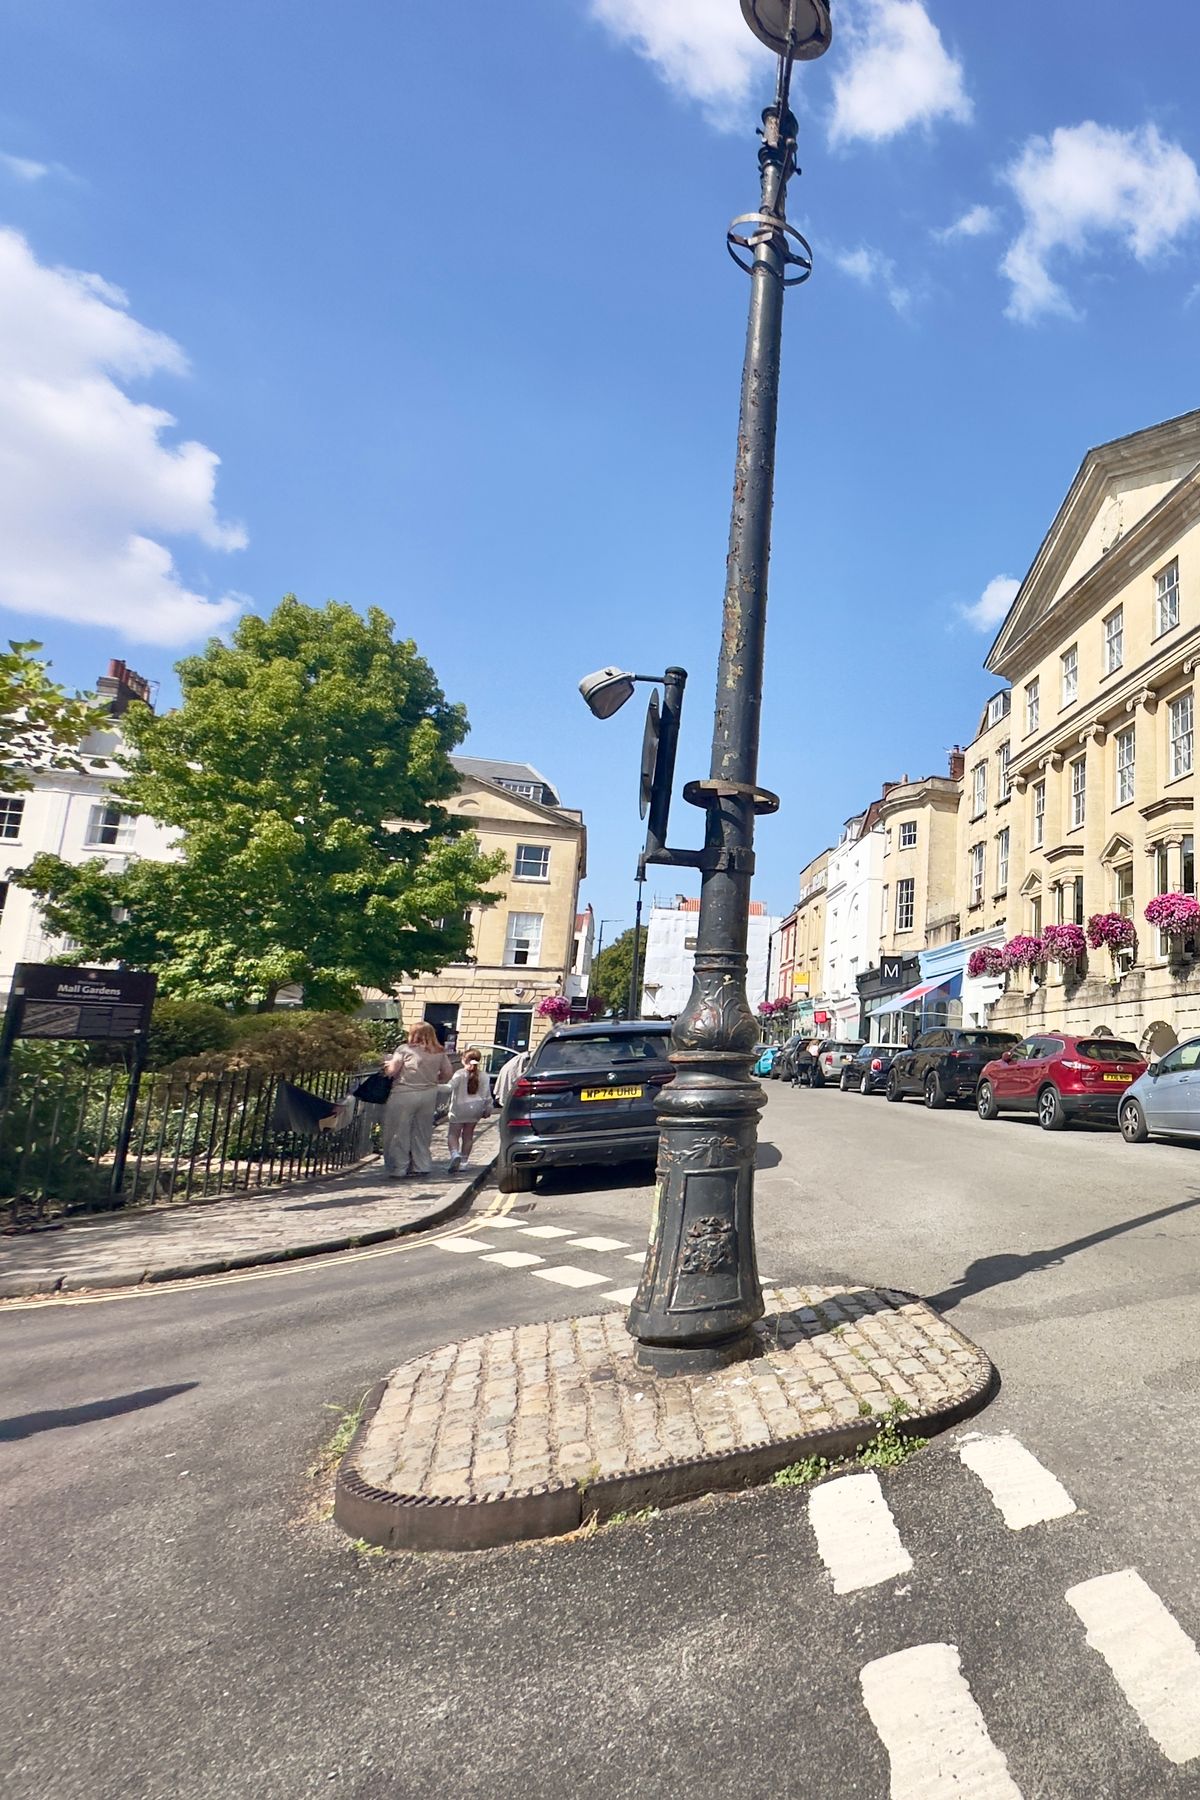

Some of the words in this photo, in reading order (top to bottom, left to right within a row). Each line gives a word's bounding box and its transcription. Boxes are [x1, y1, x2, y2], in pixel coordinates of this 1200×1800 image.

[884, 963, 899, 978] M
[57, 984, 80, 993] Mall
[82, 986, 121, 995] Gardens
[587, 1088, 613, 1098] WP74
[617, 1087, 638, 1096] UHU
